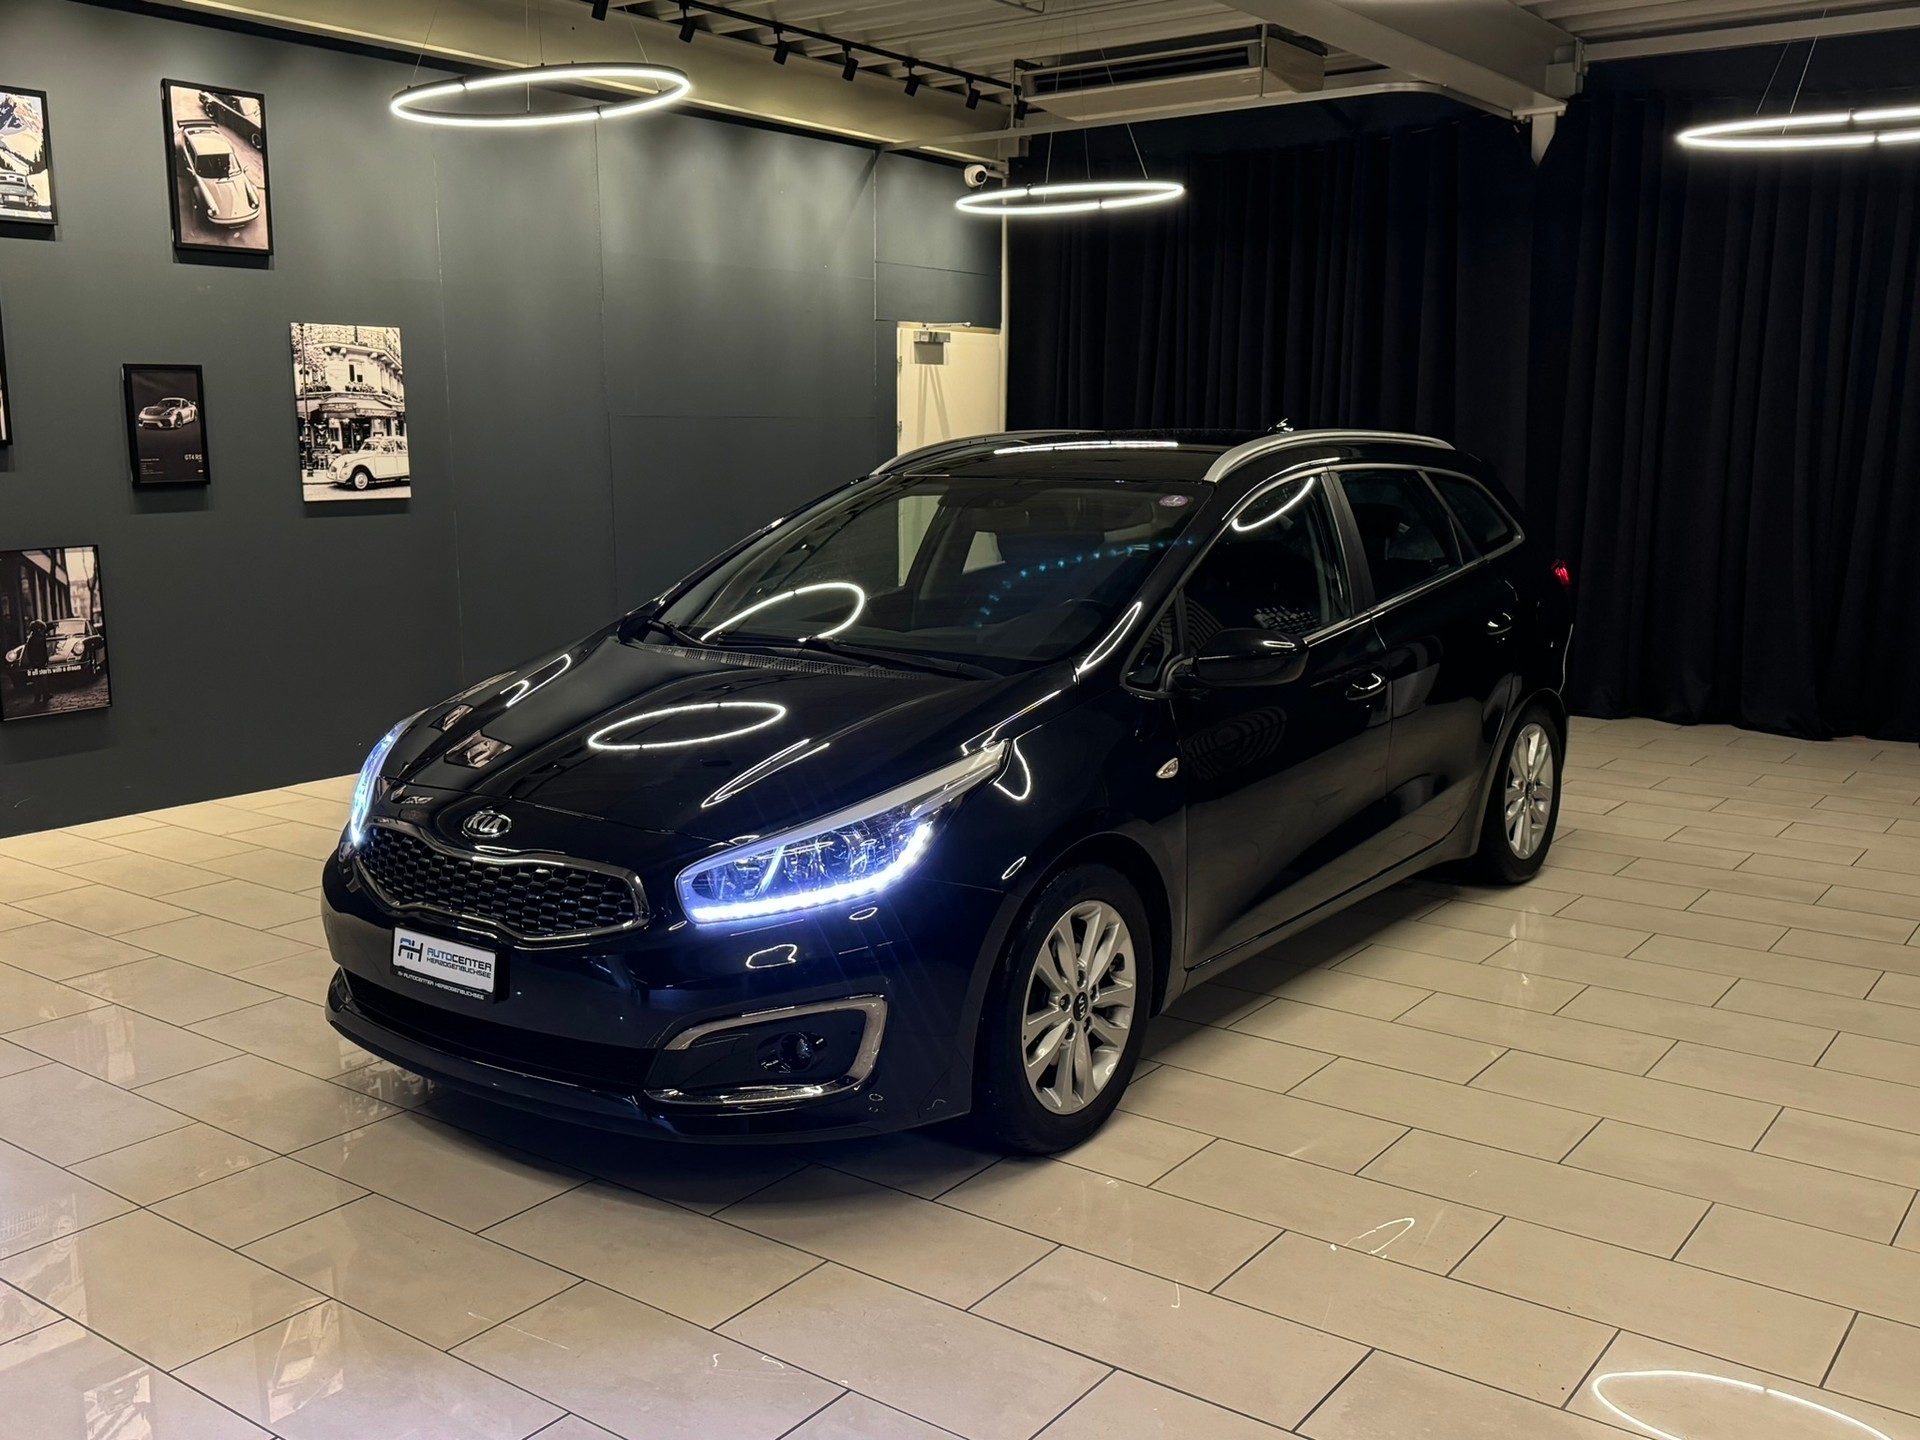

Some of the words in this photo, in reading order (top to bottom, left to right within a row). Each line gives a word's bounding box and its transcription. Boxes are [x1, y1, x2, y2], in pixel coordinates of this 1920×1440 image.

[467, 813, 502, 834] KIA
[426, 957, 492, 979] HERZOGENBUCHSEE
[427, 947, 492, 972] AUTOCENTER
